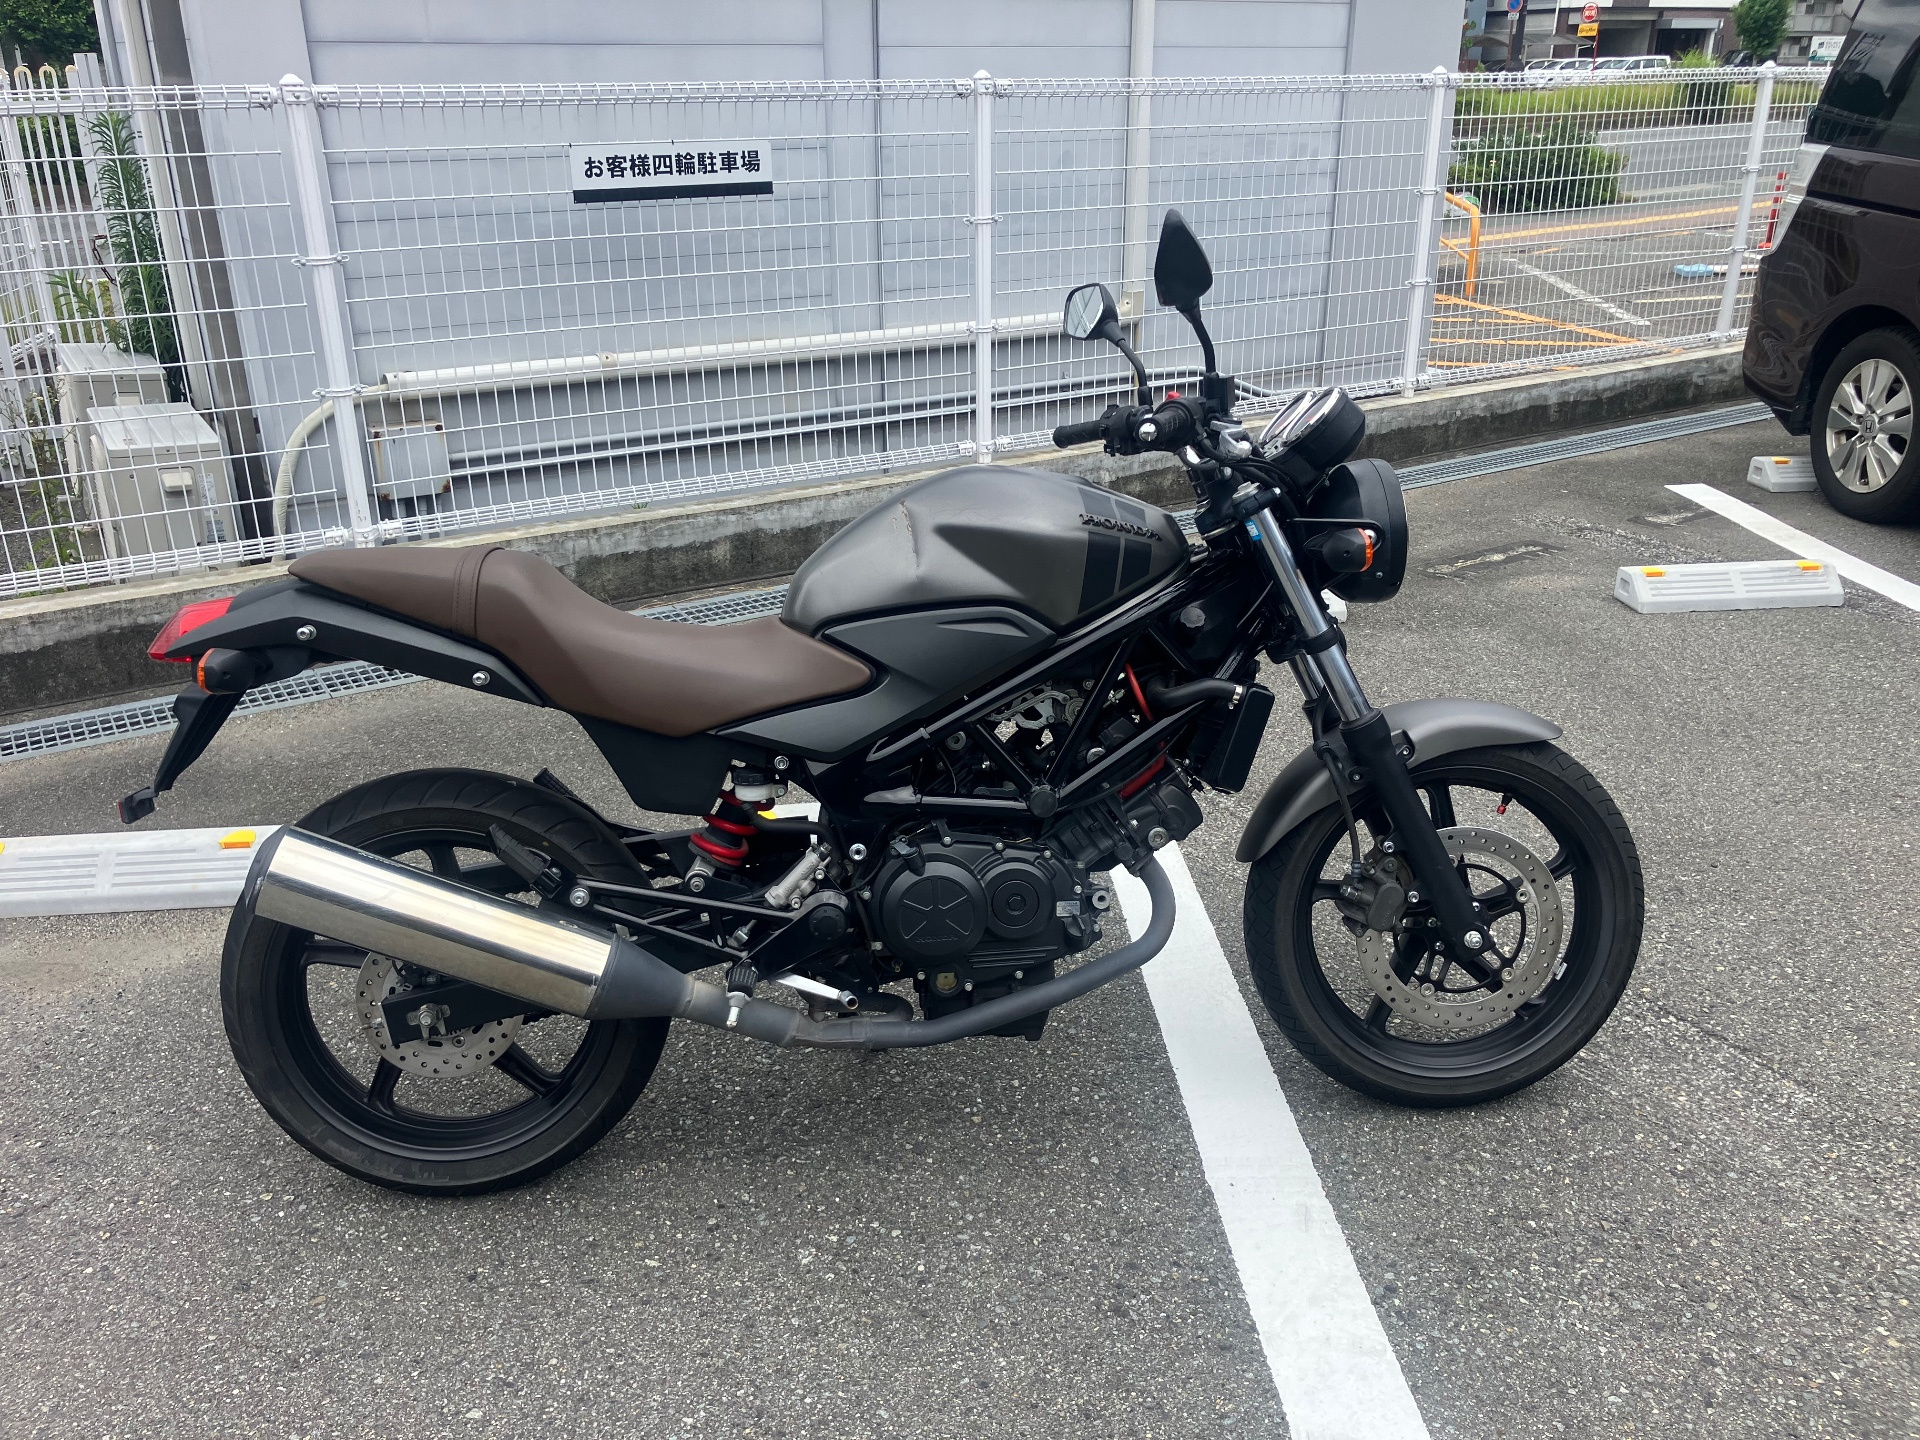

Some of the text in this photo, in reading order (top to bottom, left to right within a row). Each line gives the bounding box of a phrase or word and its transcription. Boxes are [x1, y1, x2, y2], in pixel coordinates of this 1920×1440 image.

[584, 150, 760, 178] お客様四輪駐車場
[1079, 513, 1163, 541] HONDA
